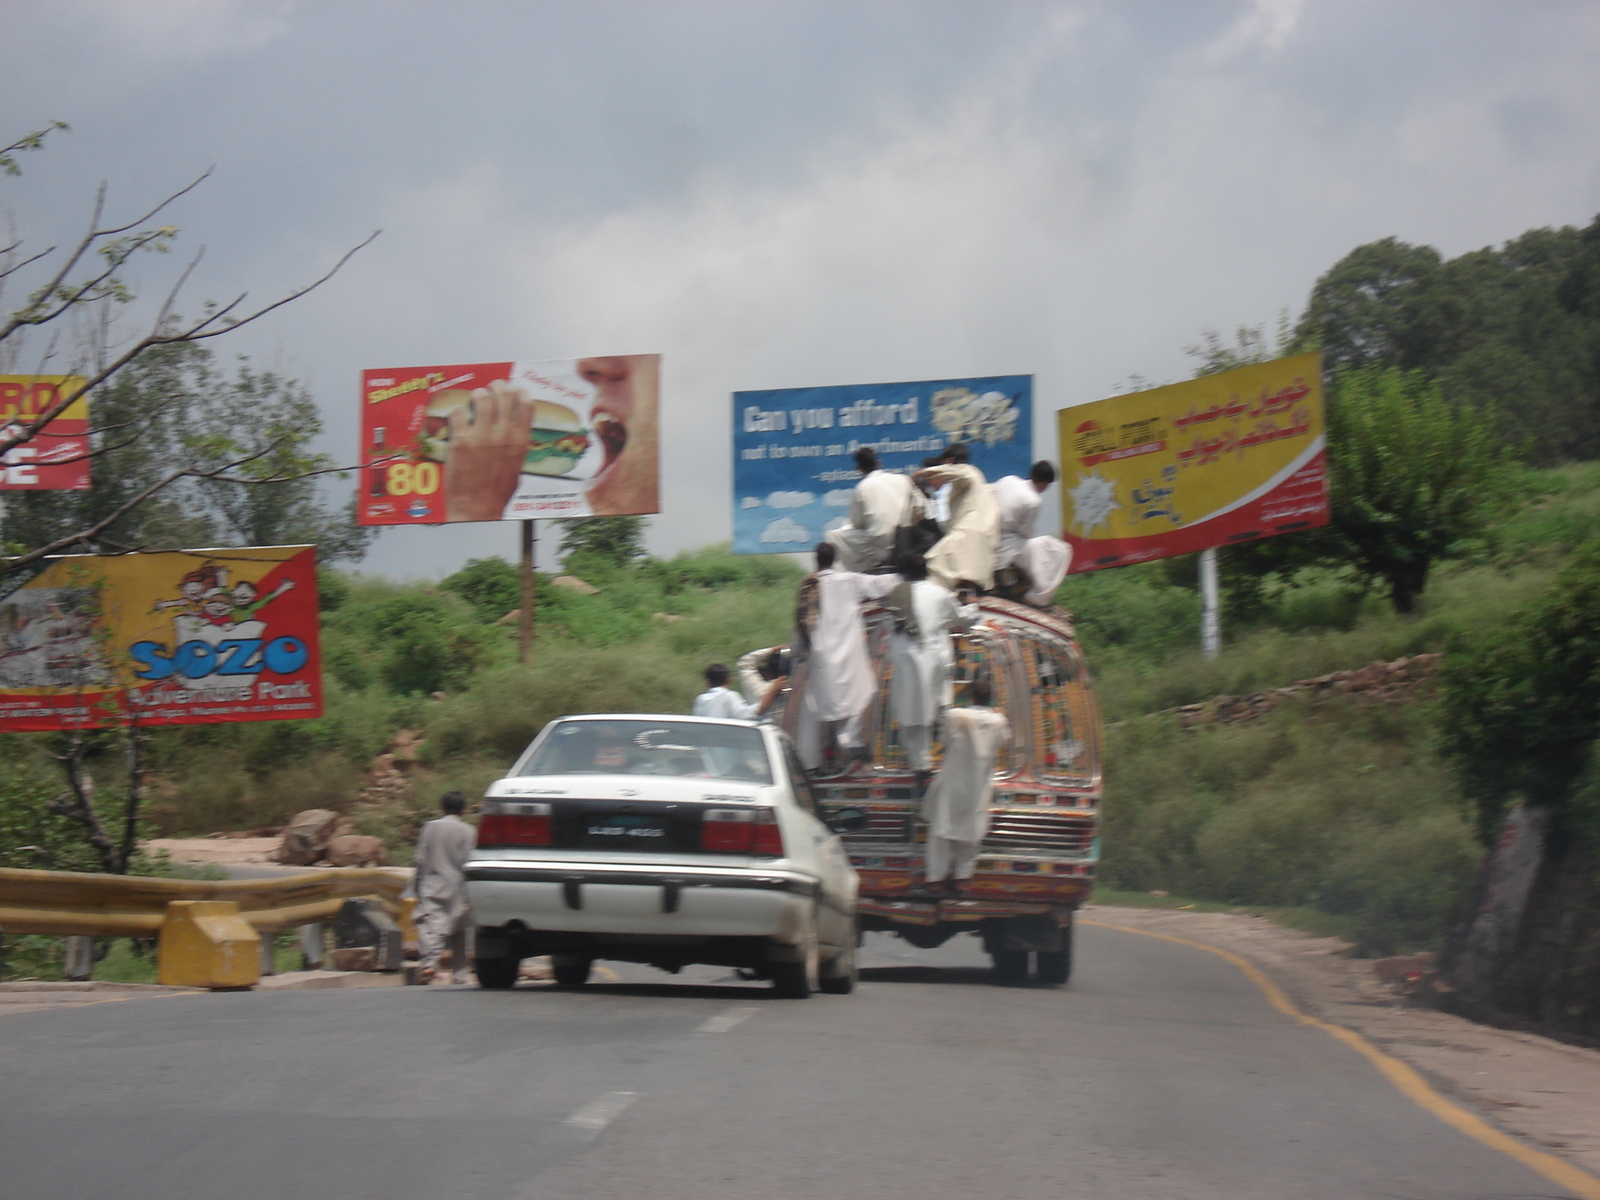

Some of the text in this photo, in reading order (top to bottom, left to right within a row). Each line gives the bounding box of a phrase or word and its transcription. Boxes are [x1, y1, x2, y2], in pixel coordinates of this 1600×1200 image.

[744, 397, 919, 435] Can you afford
[386, 462, 440, 496] 80
[129, 635, 308, 680] SOZO
[258, 680, 313, 701] Park
